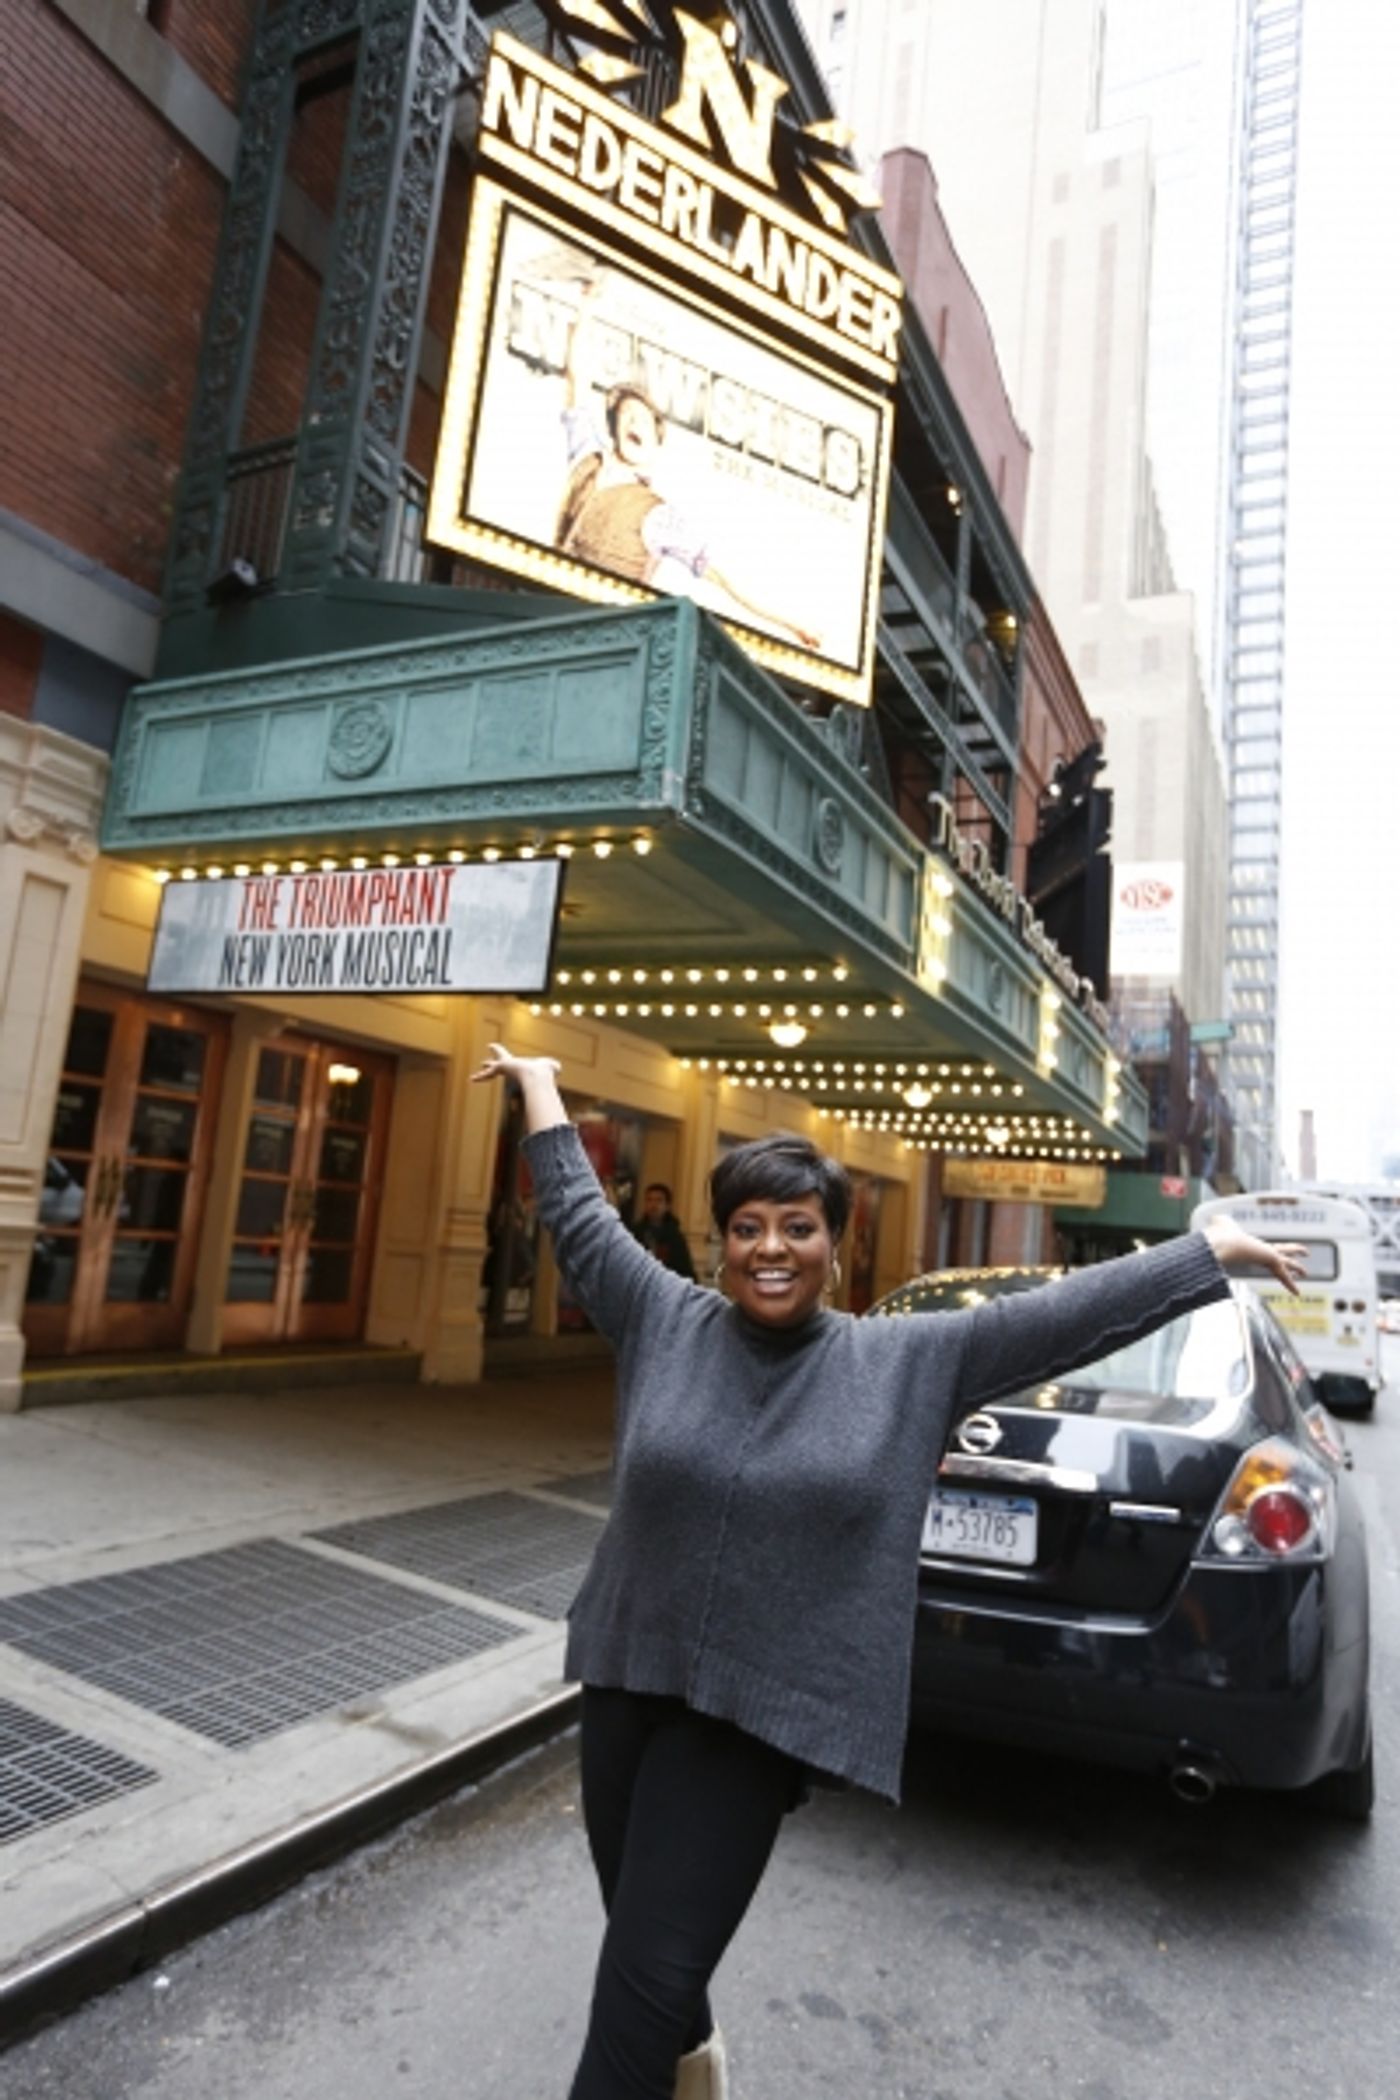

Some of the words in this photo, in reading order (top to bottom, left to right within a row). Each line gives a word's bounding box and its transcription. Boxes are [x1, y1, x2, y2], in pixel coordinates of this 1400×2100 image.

[661, 6, 790, 190] N
[482, 55, 900, 362] NEDERLANDER
[218, 933, 273, 987] NEW
[276, 931, 340, 987] YORK
[341, 927, 454, 986] MUSICAL
[238, 878, 284, 931] THE
[287, 867, 456, 930] TRIUMPHANT
